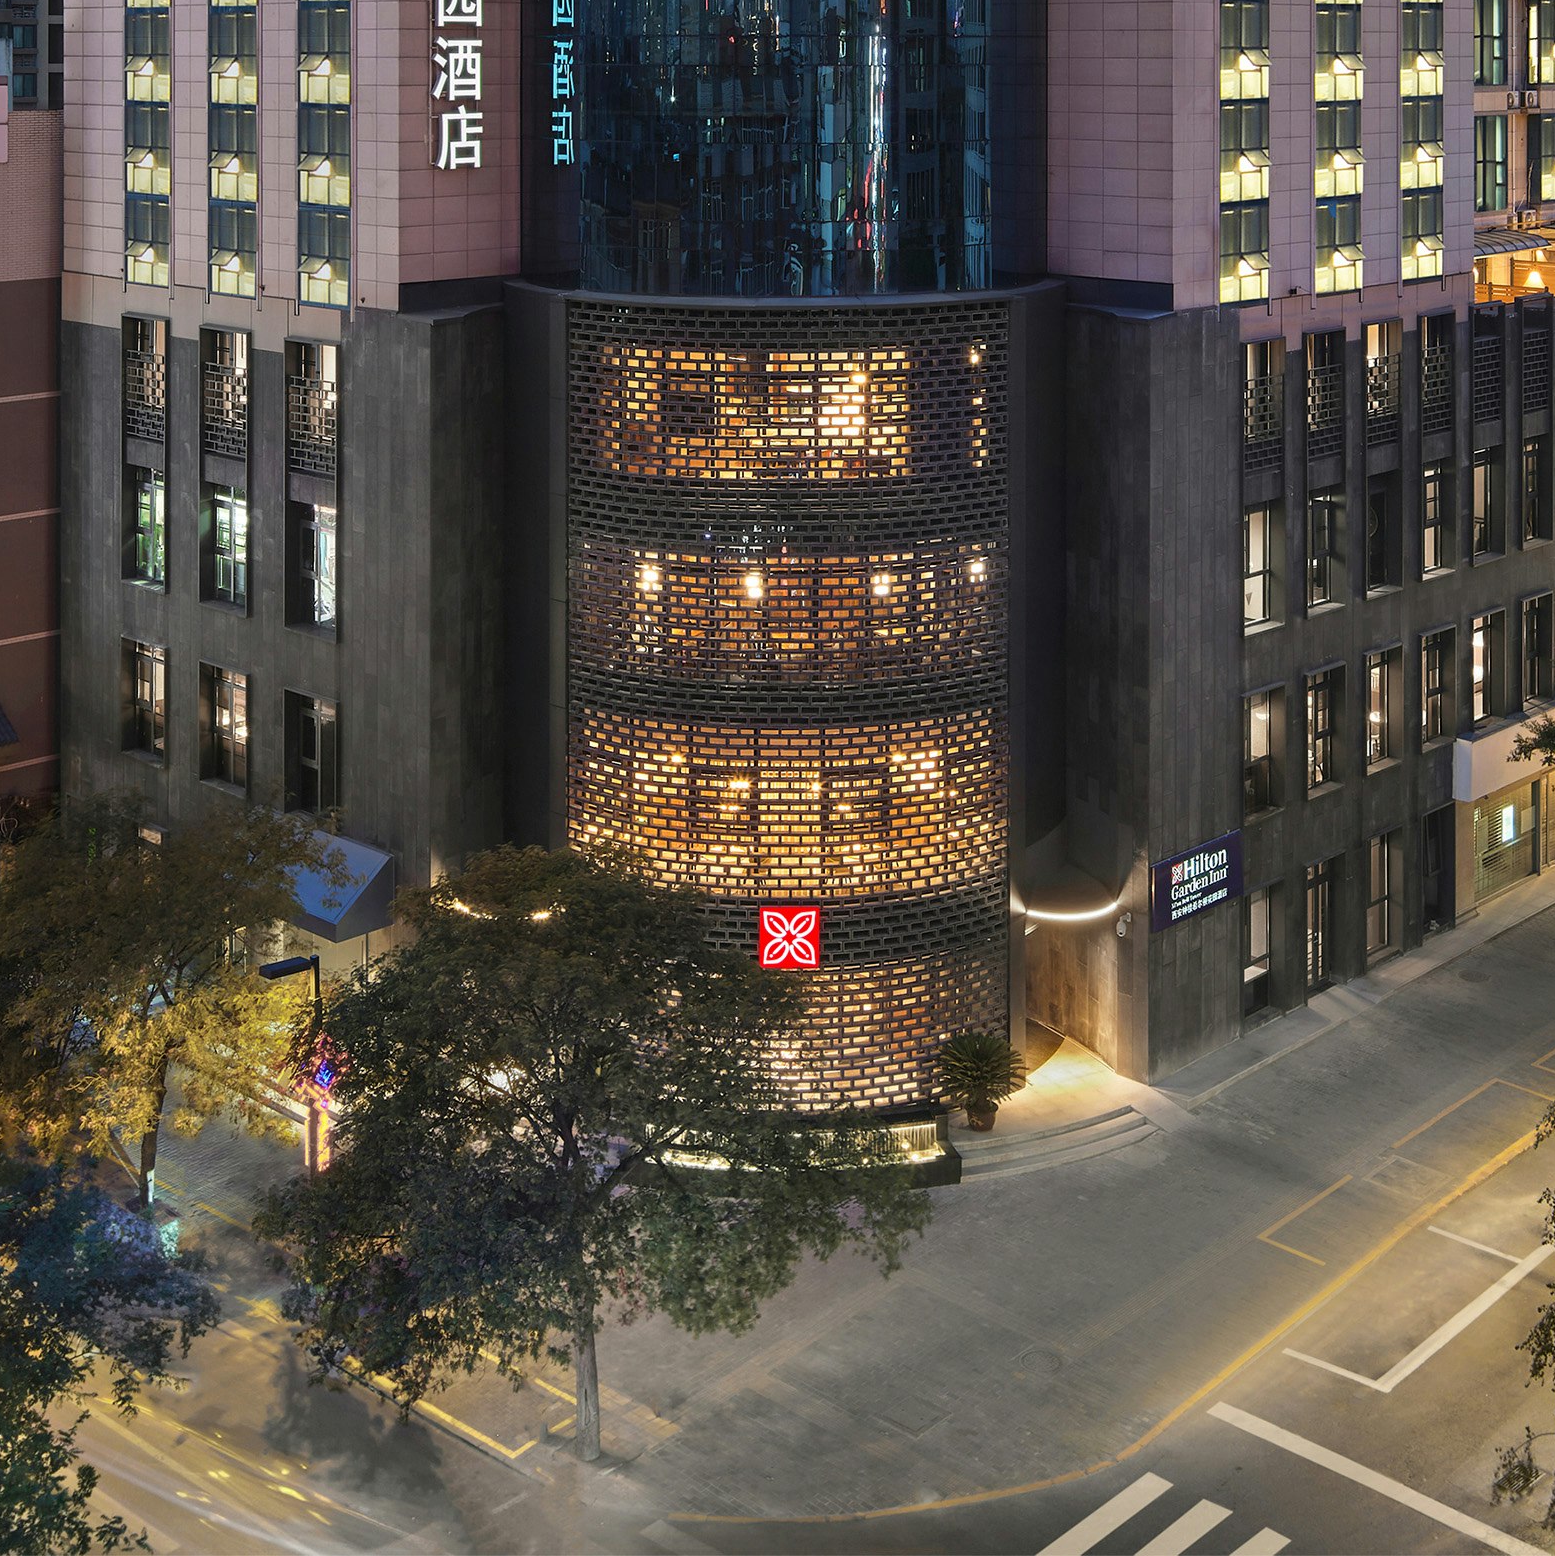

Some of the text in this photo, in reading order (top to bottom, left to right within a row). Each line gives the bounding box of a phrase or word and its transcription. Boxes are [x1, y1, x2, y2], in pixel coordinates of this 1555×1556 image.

[1184, 849, 1227, 881] Hilton
[1171, 868, 1228, 901] Garden Inn
